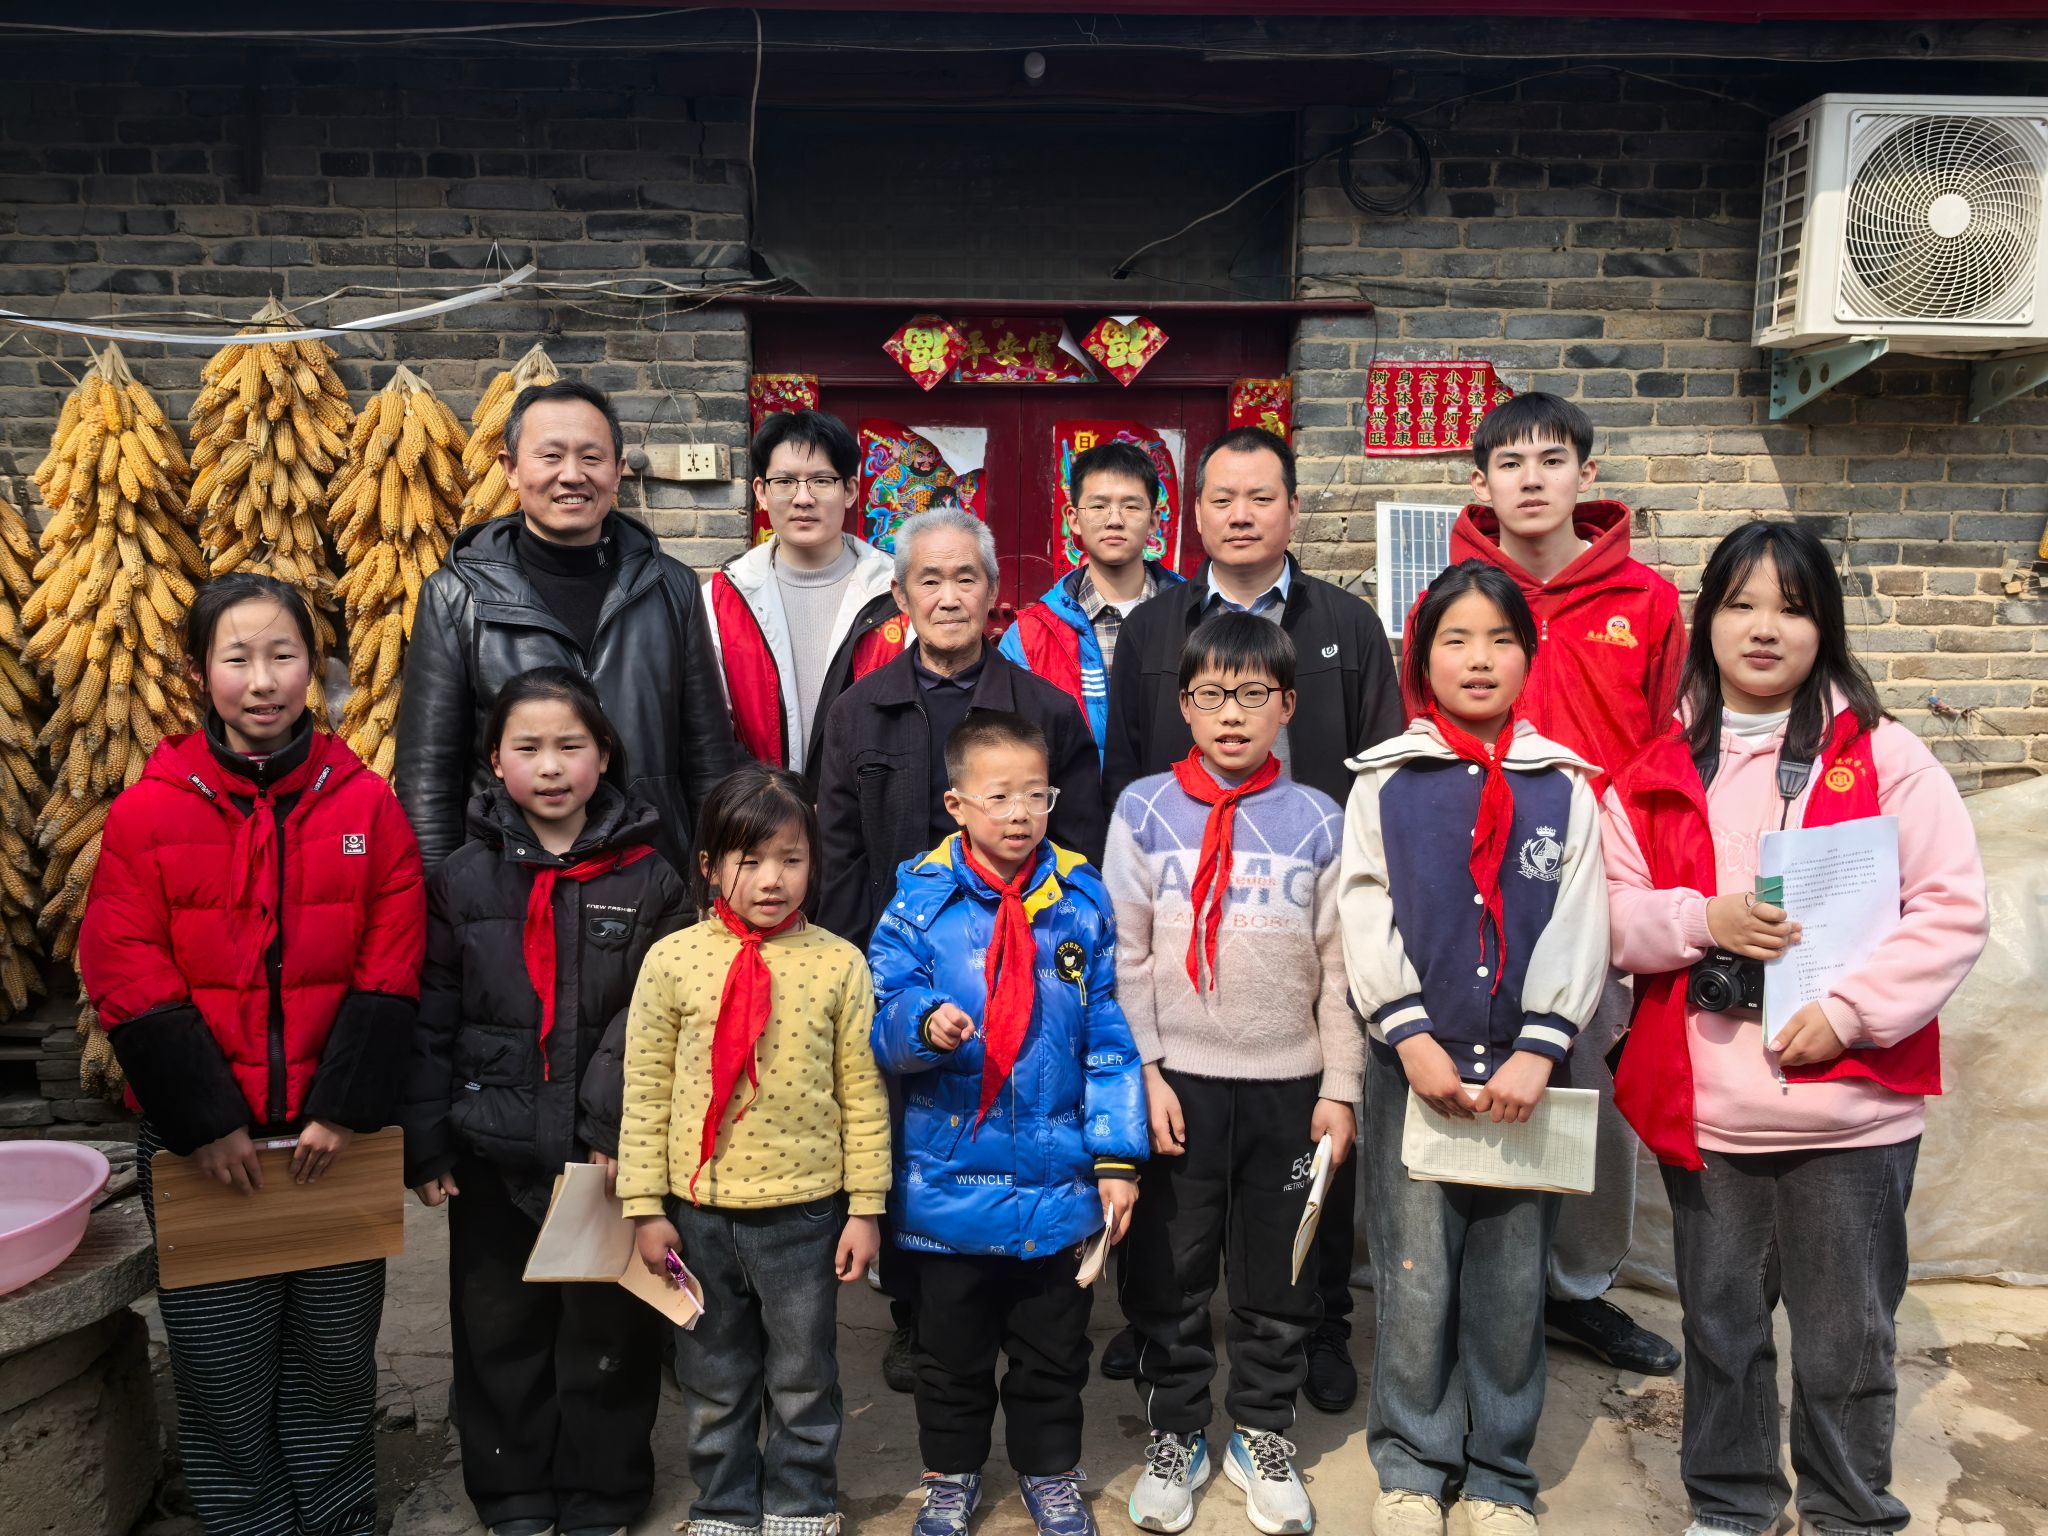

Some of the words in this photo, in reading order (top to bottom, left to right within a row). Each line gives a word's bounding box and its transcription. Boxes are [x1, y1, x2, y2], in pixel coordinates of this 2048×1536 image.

[961, 330, 1074, 372] 平安富
[1369, 370, 1389, 446] 树木兴旺
[1393, 370, 1414, 446] 身体健康
[1418, 371, 1438, 446] 六畜兴旺
[1441, 371, 1462, 446] 小心灯火
[1466, 370, 1487, 446] 川流不
[1057, 942, 1083, 955] INVENT
[955, 1174, 1013, 1186] WKNCLE
